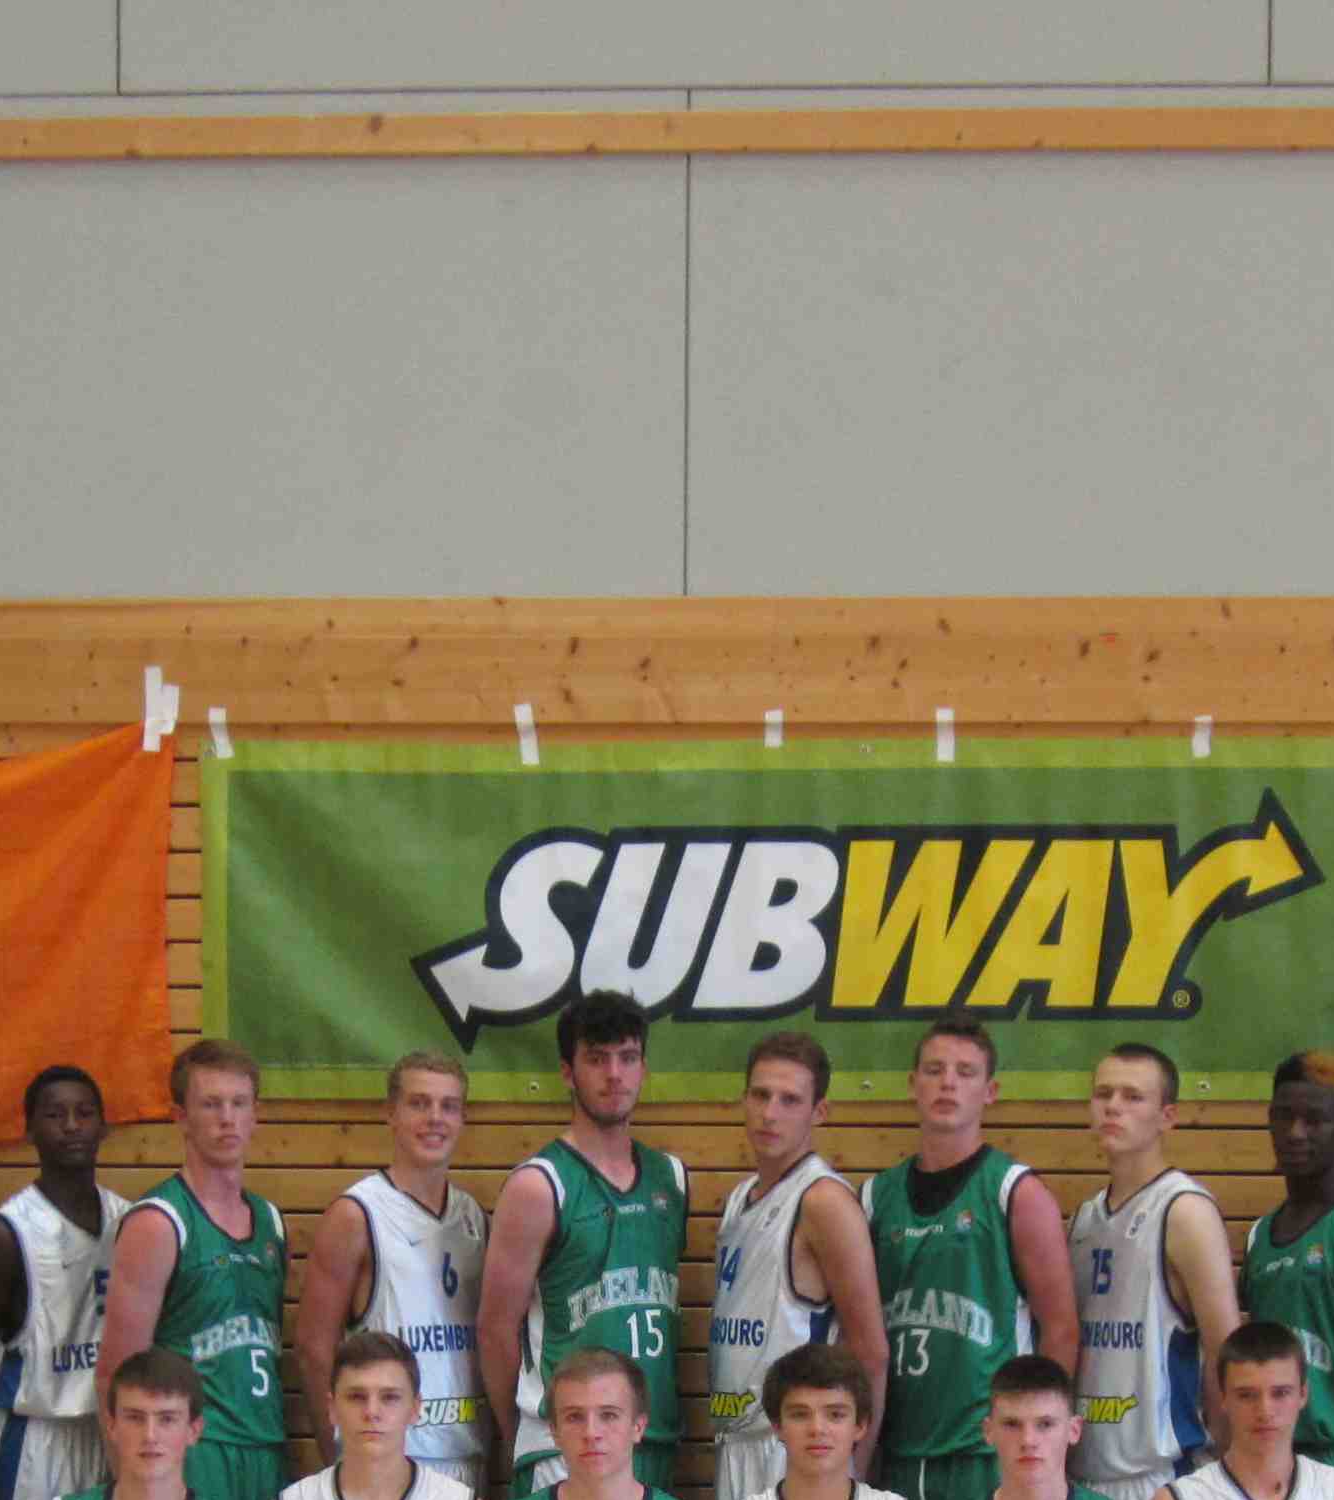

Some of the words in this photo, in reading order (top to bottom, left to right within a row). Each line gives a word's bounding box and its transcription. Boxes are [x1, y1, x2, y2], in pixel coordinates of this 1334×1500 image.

[429, 820, 1305, 1024] SUBWAY
[443, 1252, 458, 1299] 6
[1091, 1247, 1113, 1295] 15
[626, 1308, 665, 1358] 15
[712, 1317, 764, 1346] BOURG
[896, 1327, 930, 1376] 13
[250, 1348, 269, 1397] 5
[711, 1391, 756, 1418] WAY
